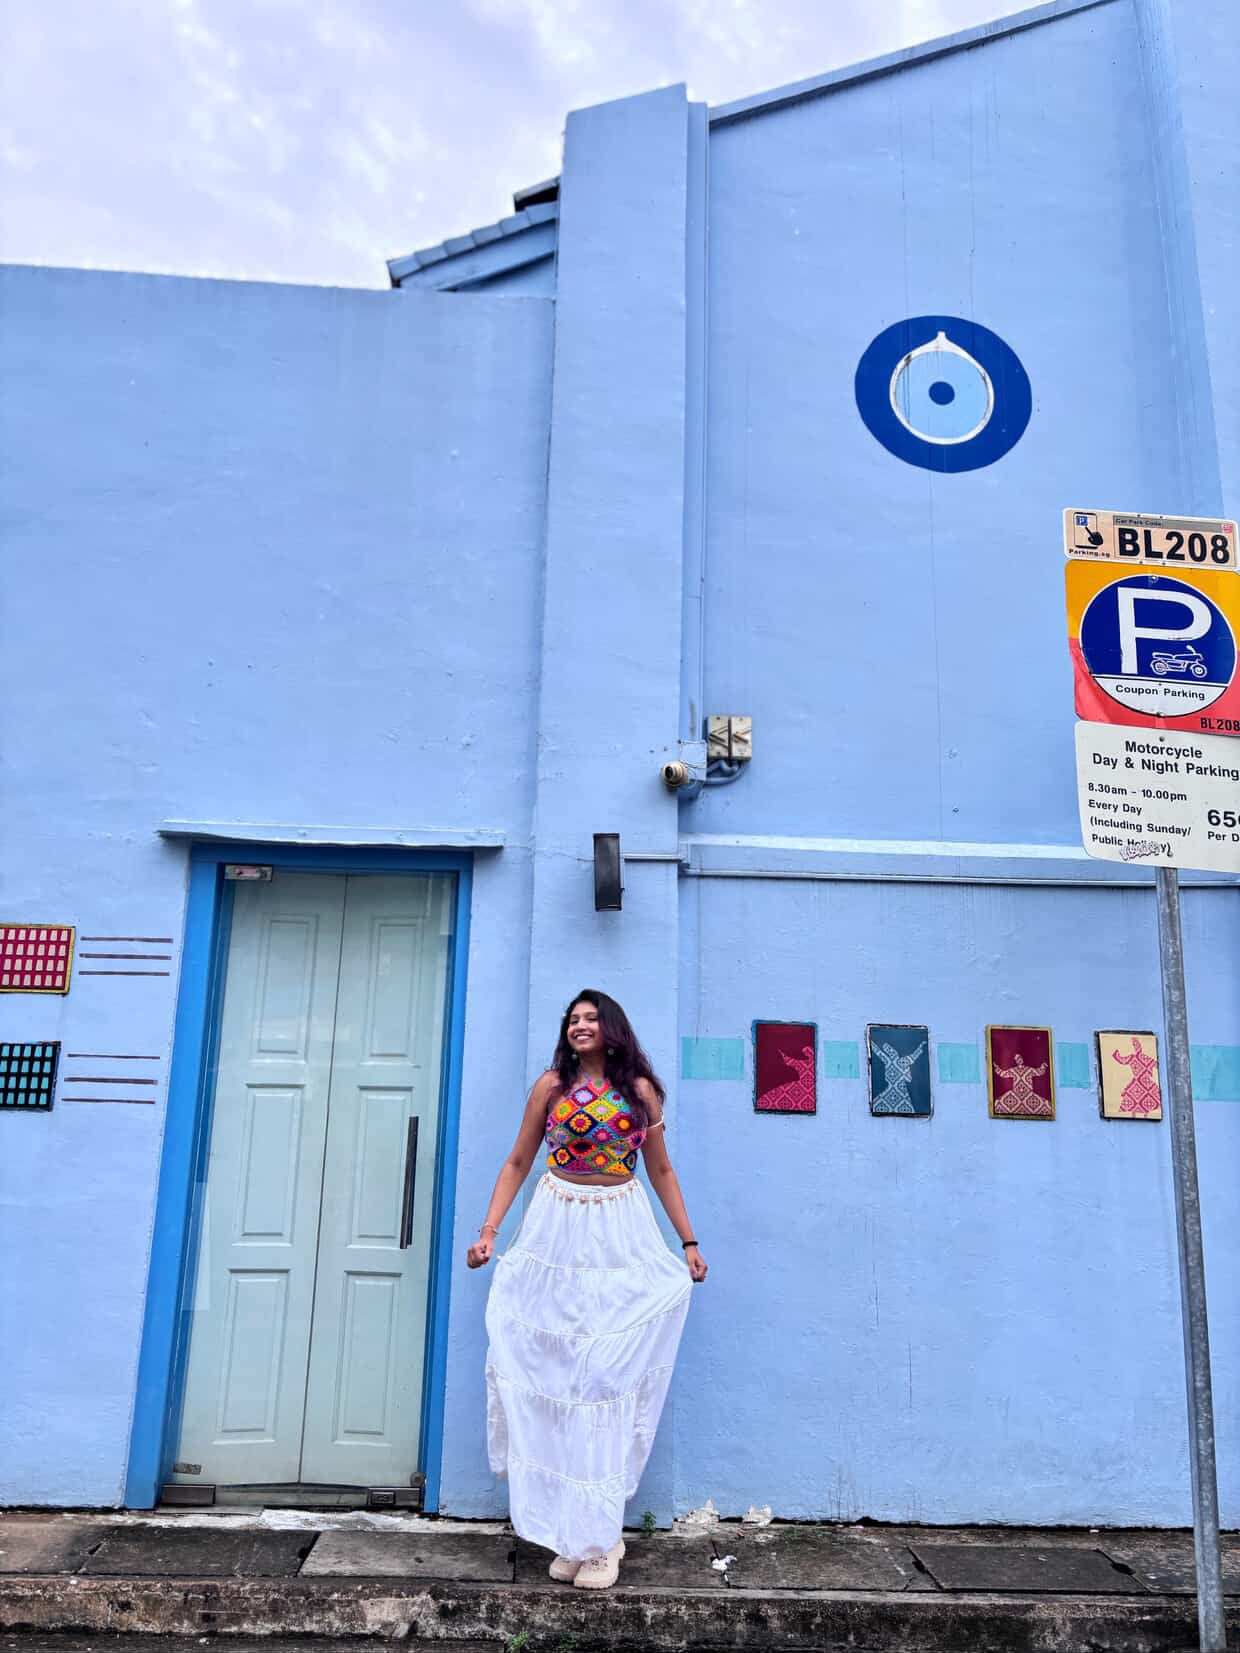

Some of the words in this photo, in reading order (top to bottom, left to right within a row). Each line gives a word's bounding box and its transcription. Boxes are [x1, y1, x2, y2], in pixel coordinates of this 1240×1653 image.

[1118, 527, 1230, 564] BL208
[1117, 586, 1212, 675] P
[1115, 684, 1159, 696] Coupon
[1164, 688, 1205, 701] Parking
[1200, 717, 1240, 731] BL208
[1125, 741, 1203, 759] Motorcycle
[1092, 753, 1118, 769] Day
[1124, 757, 1135, 769] &
[1141, 759, 1179, 775] Night
[1186, 763, 1240, 781] Parking
[1088, 782, 1128, 796] 8.30am
[1141, 788, 1187, 802] 10.00pm
[1088, 799, 1119, 813] Every
[1122, 803, 1142, 816] Day
[1090, 816, 1143, 833] (Including
[1147, 823, 1191, 837] Sunday/
[1207, 809, 1240, 828] 65
[1092, 834, 1124, 847] Public
[1207, 831, 1227, 841] Per
[1231, 833, 1240, 842] D
